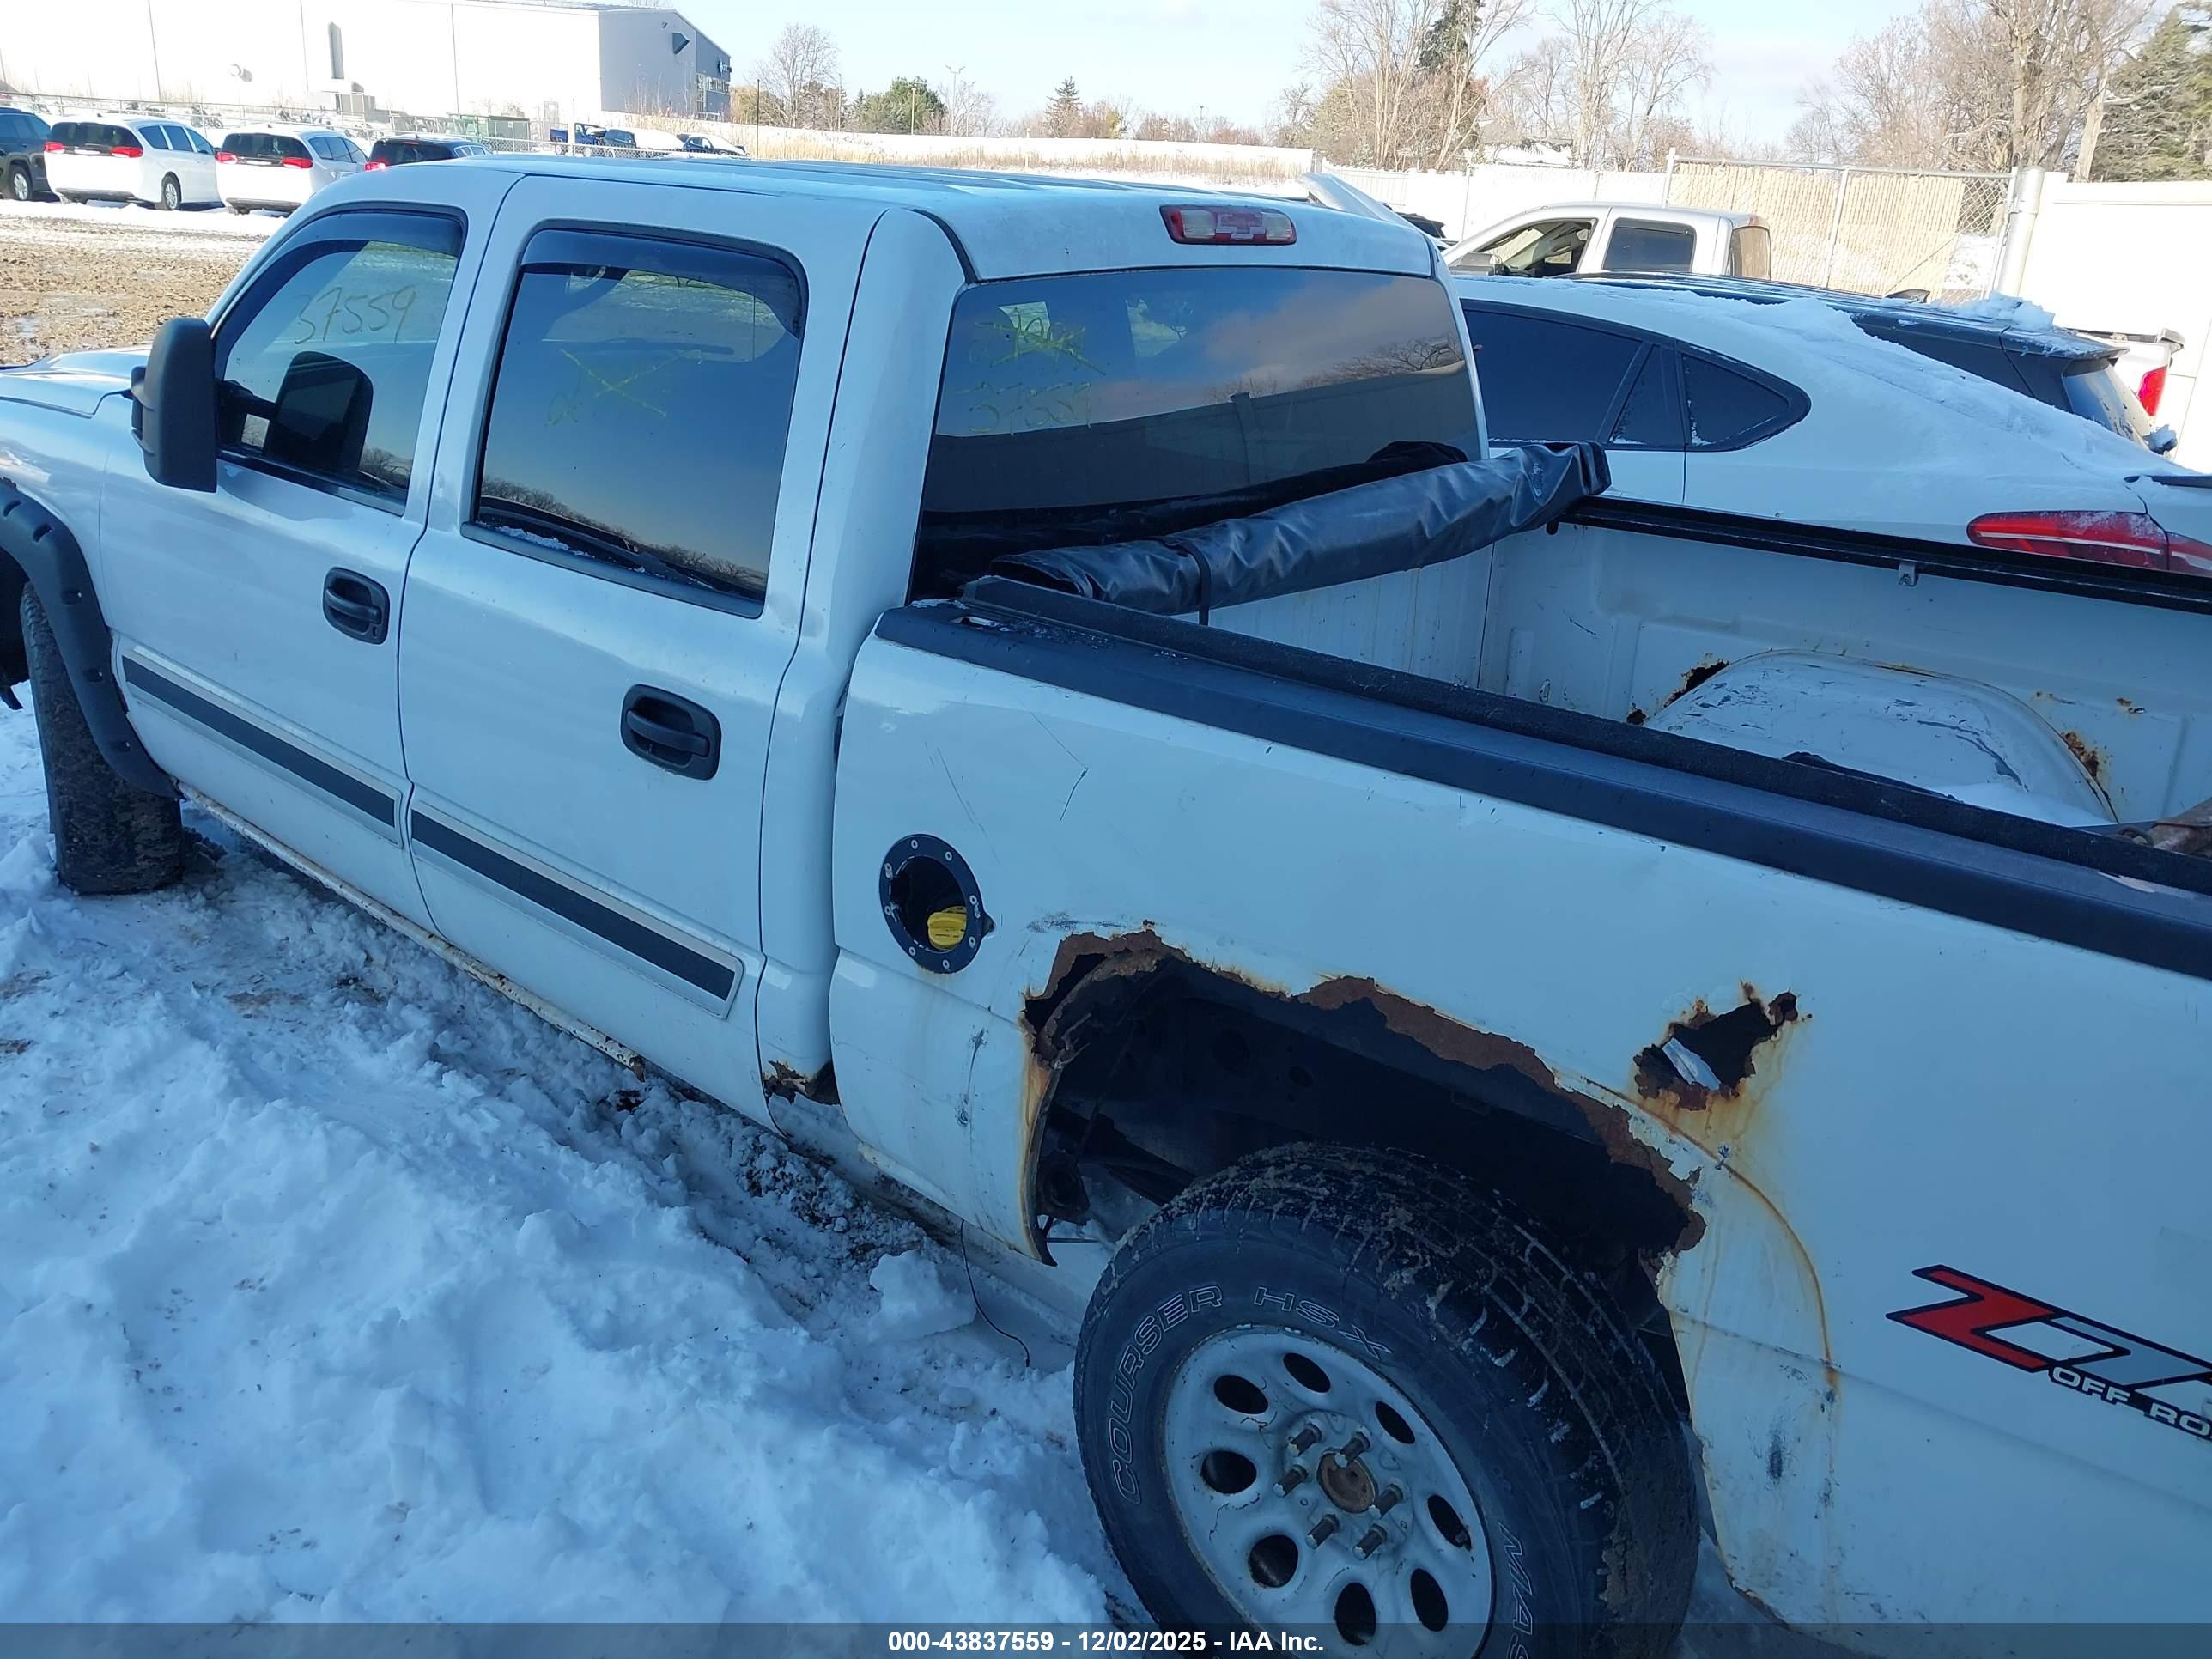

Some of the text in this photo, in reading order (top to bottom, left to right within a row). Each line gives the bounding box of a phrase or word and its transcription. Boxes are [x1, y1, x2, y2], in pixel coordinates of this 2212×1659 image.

[293, 284, 416, 344] 37559
[1253, 1285, 1392, 1361] HSX
[1886, 1264, 2212, 1390] Z7
[1109, 1285, 1224, 1504] COURSER
[2052, 1366, 2212, 1438] OFF RO
